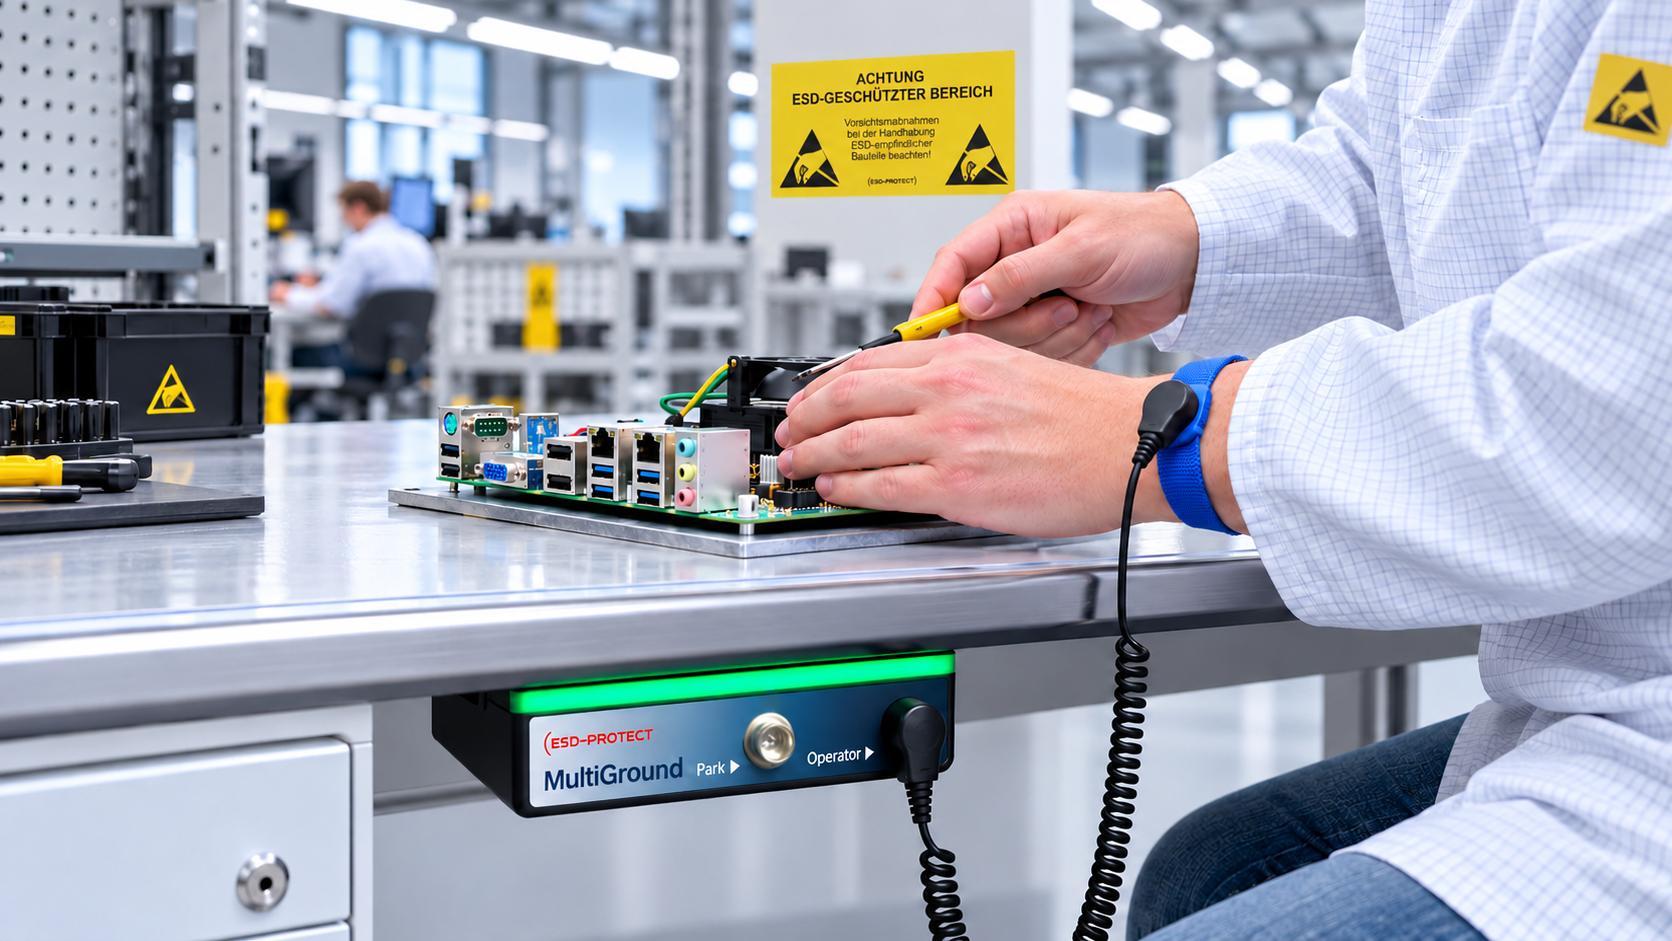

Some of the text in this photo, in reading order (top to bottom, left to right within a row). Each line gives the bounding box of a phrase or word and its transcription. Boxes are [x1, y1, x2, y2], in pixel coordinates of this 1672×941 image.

[856, 70, 924, 85] ACHTUNG
[792, 85, 993, 105] ESD-GESCHÜTZTER BEREICH
[862, 130, 877, 138] der
[879, 128, 936, 138] Handhabung
[851, 150, 932, 161] Bauteile beachten!
[806, 749, 862, 767] Operator
[544, 756, 683, 791] MultiGround
[696, 761, 725, 777] Park
